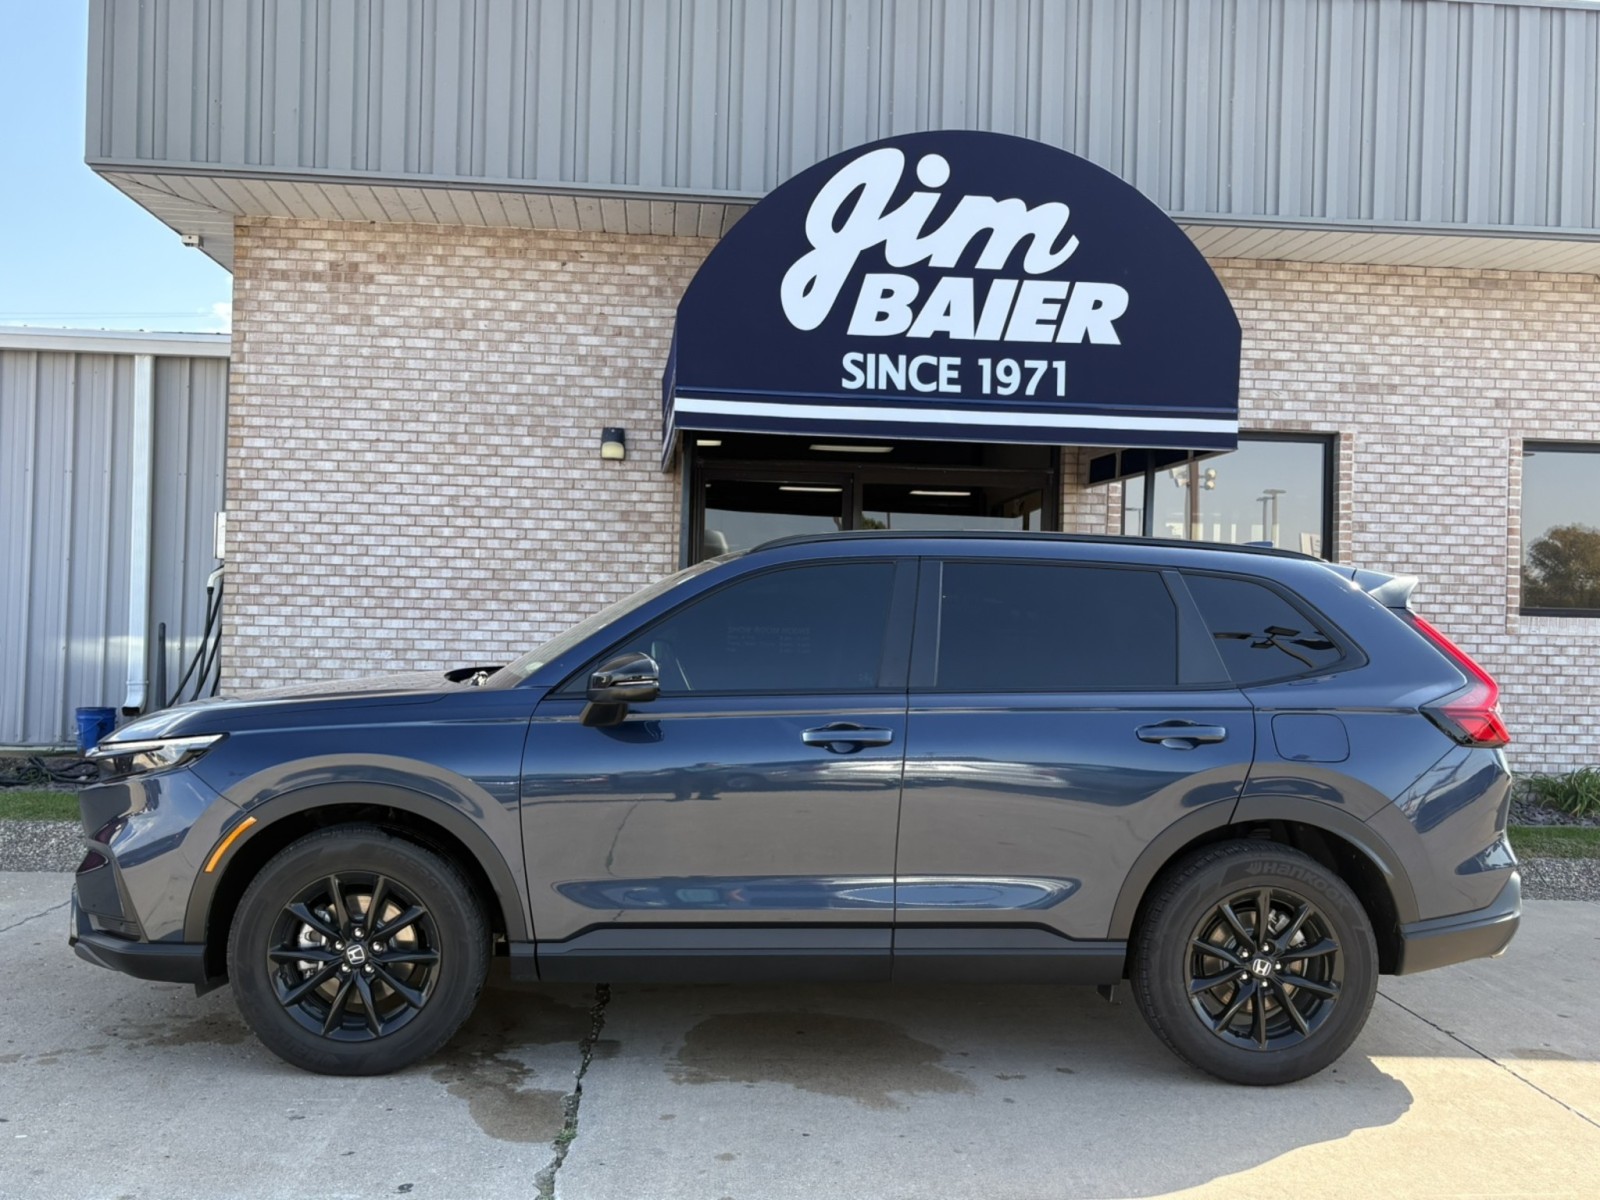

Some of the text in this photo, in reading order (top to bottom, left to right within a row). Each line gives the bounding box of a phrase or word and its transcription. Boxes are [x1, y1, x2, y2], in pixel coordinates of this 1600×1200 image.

[780, 147, 1080, 331] Jim
[846, 273, 1129, 345] BAIER
[841, 351, 1066, 397] SINCE 1971
